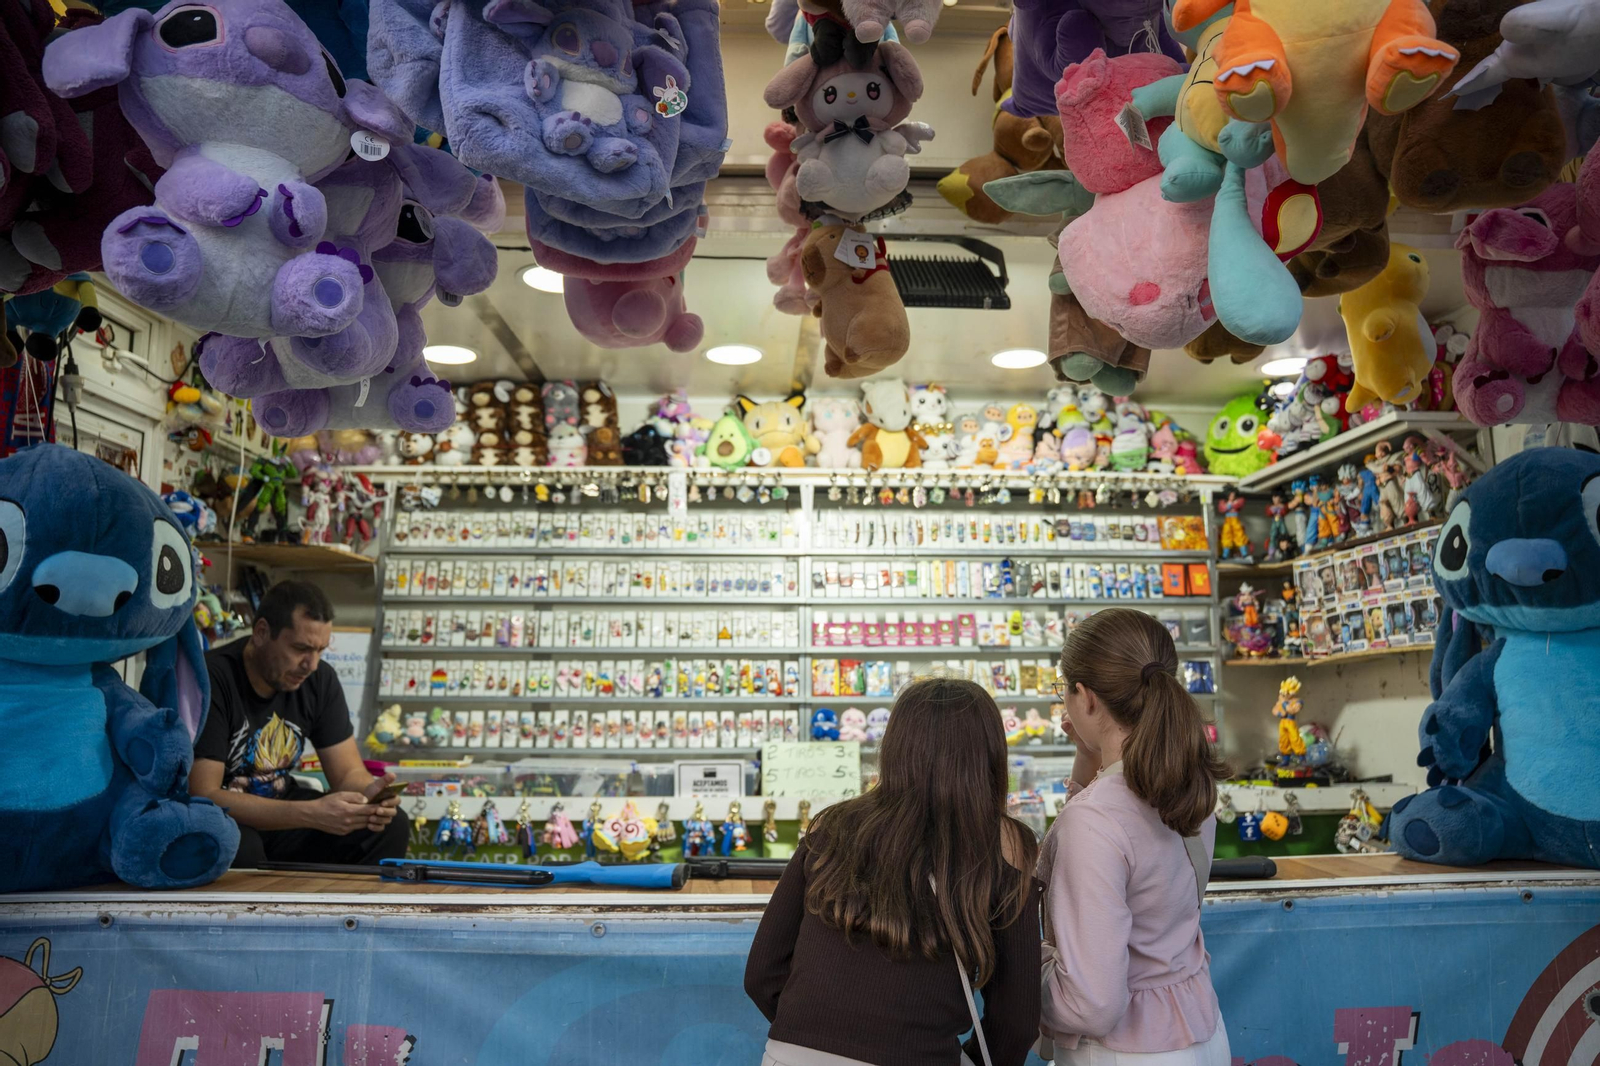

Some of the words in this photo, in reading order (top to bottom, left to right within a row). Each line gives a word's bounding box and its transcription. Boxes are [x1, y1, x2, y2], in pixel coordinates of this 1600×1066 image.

[767, 744, 779, 760] 2
[784, 744, 826, 759] TIROS
[765, 768, 779, 783] 5
[783, 765, 827, 779] TIROS
